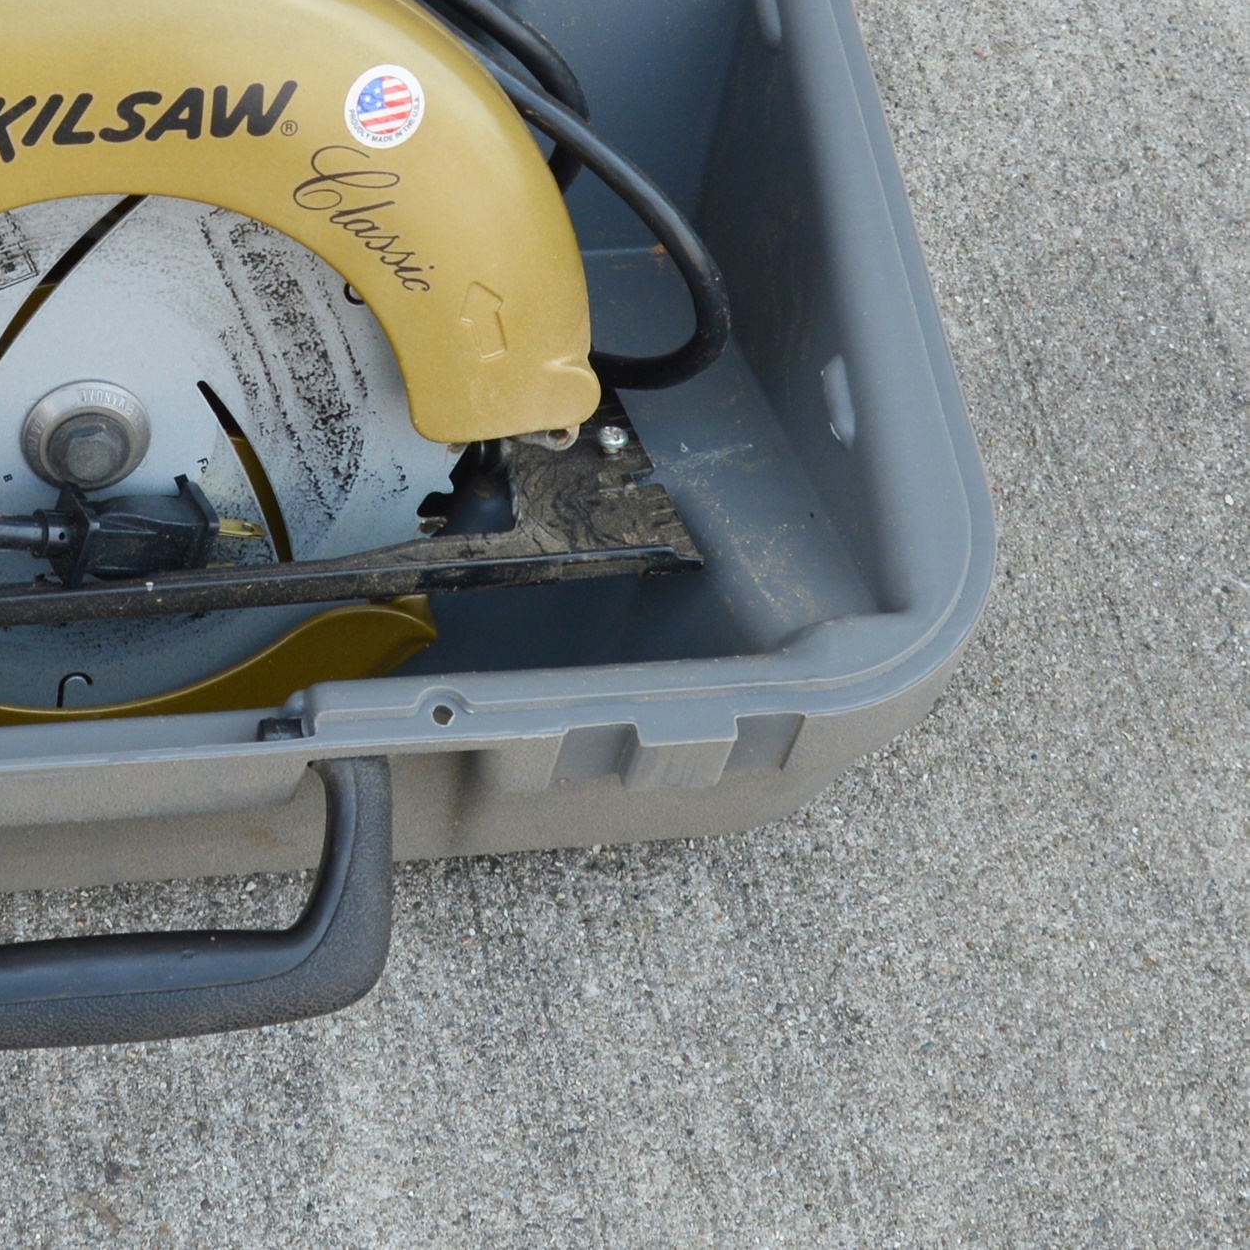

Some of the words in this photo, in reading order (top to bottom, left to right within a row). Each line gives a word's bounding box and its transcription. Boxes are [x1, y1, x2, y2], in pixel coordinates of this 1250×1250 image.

[349, 109, 371, 139] PROUDLY
[371, 135, 393, 143] MADE
[394, 130, 404, 139] IN
[403, 119, 416, 132] THE
[292, 144, 431, 294] Classic
